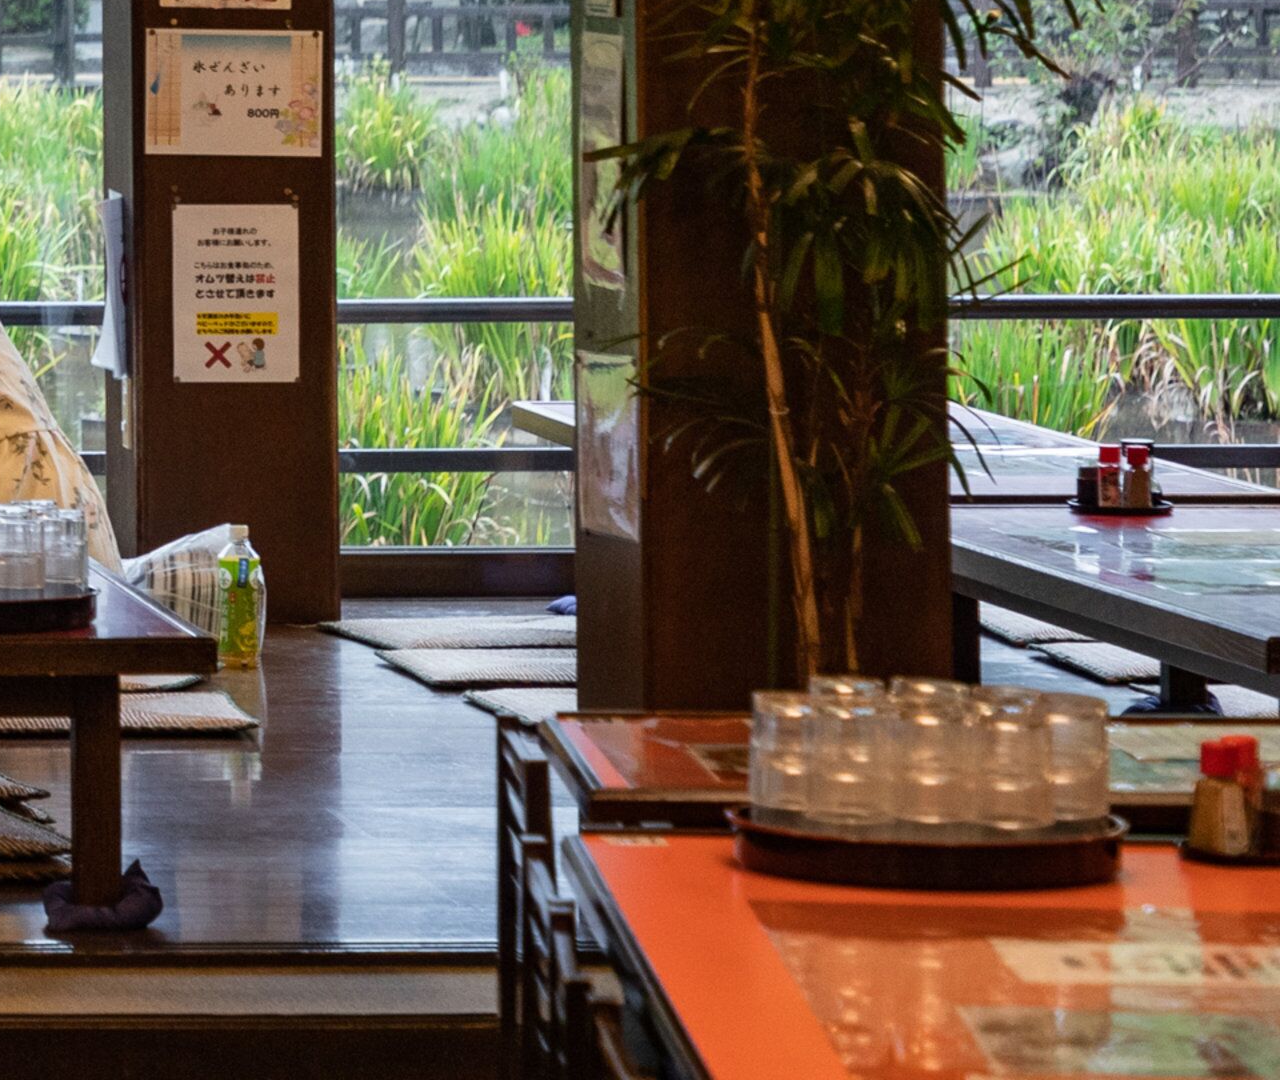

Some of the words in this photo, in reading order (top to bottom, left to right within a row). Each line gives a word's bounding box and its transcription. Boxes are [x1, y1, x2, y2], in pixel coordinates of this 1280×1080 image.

[224, 83, 281, 98] あります
[246, 108, 280, 119] 800円
[195, 273, 276, 284] オムツ替えは禁止
[195, 288, 275, 300] とさせて頂きます
